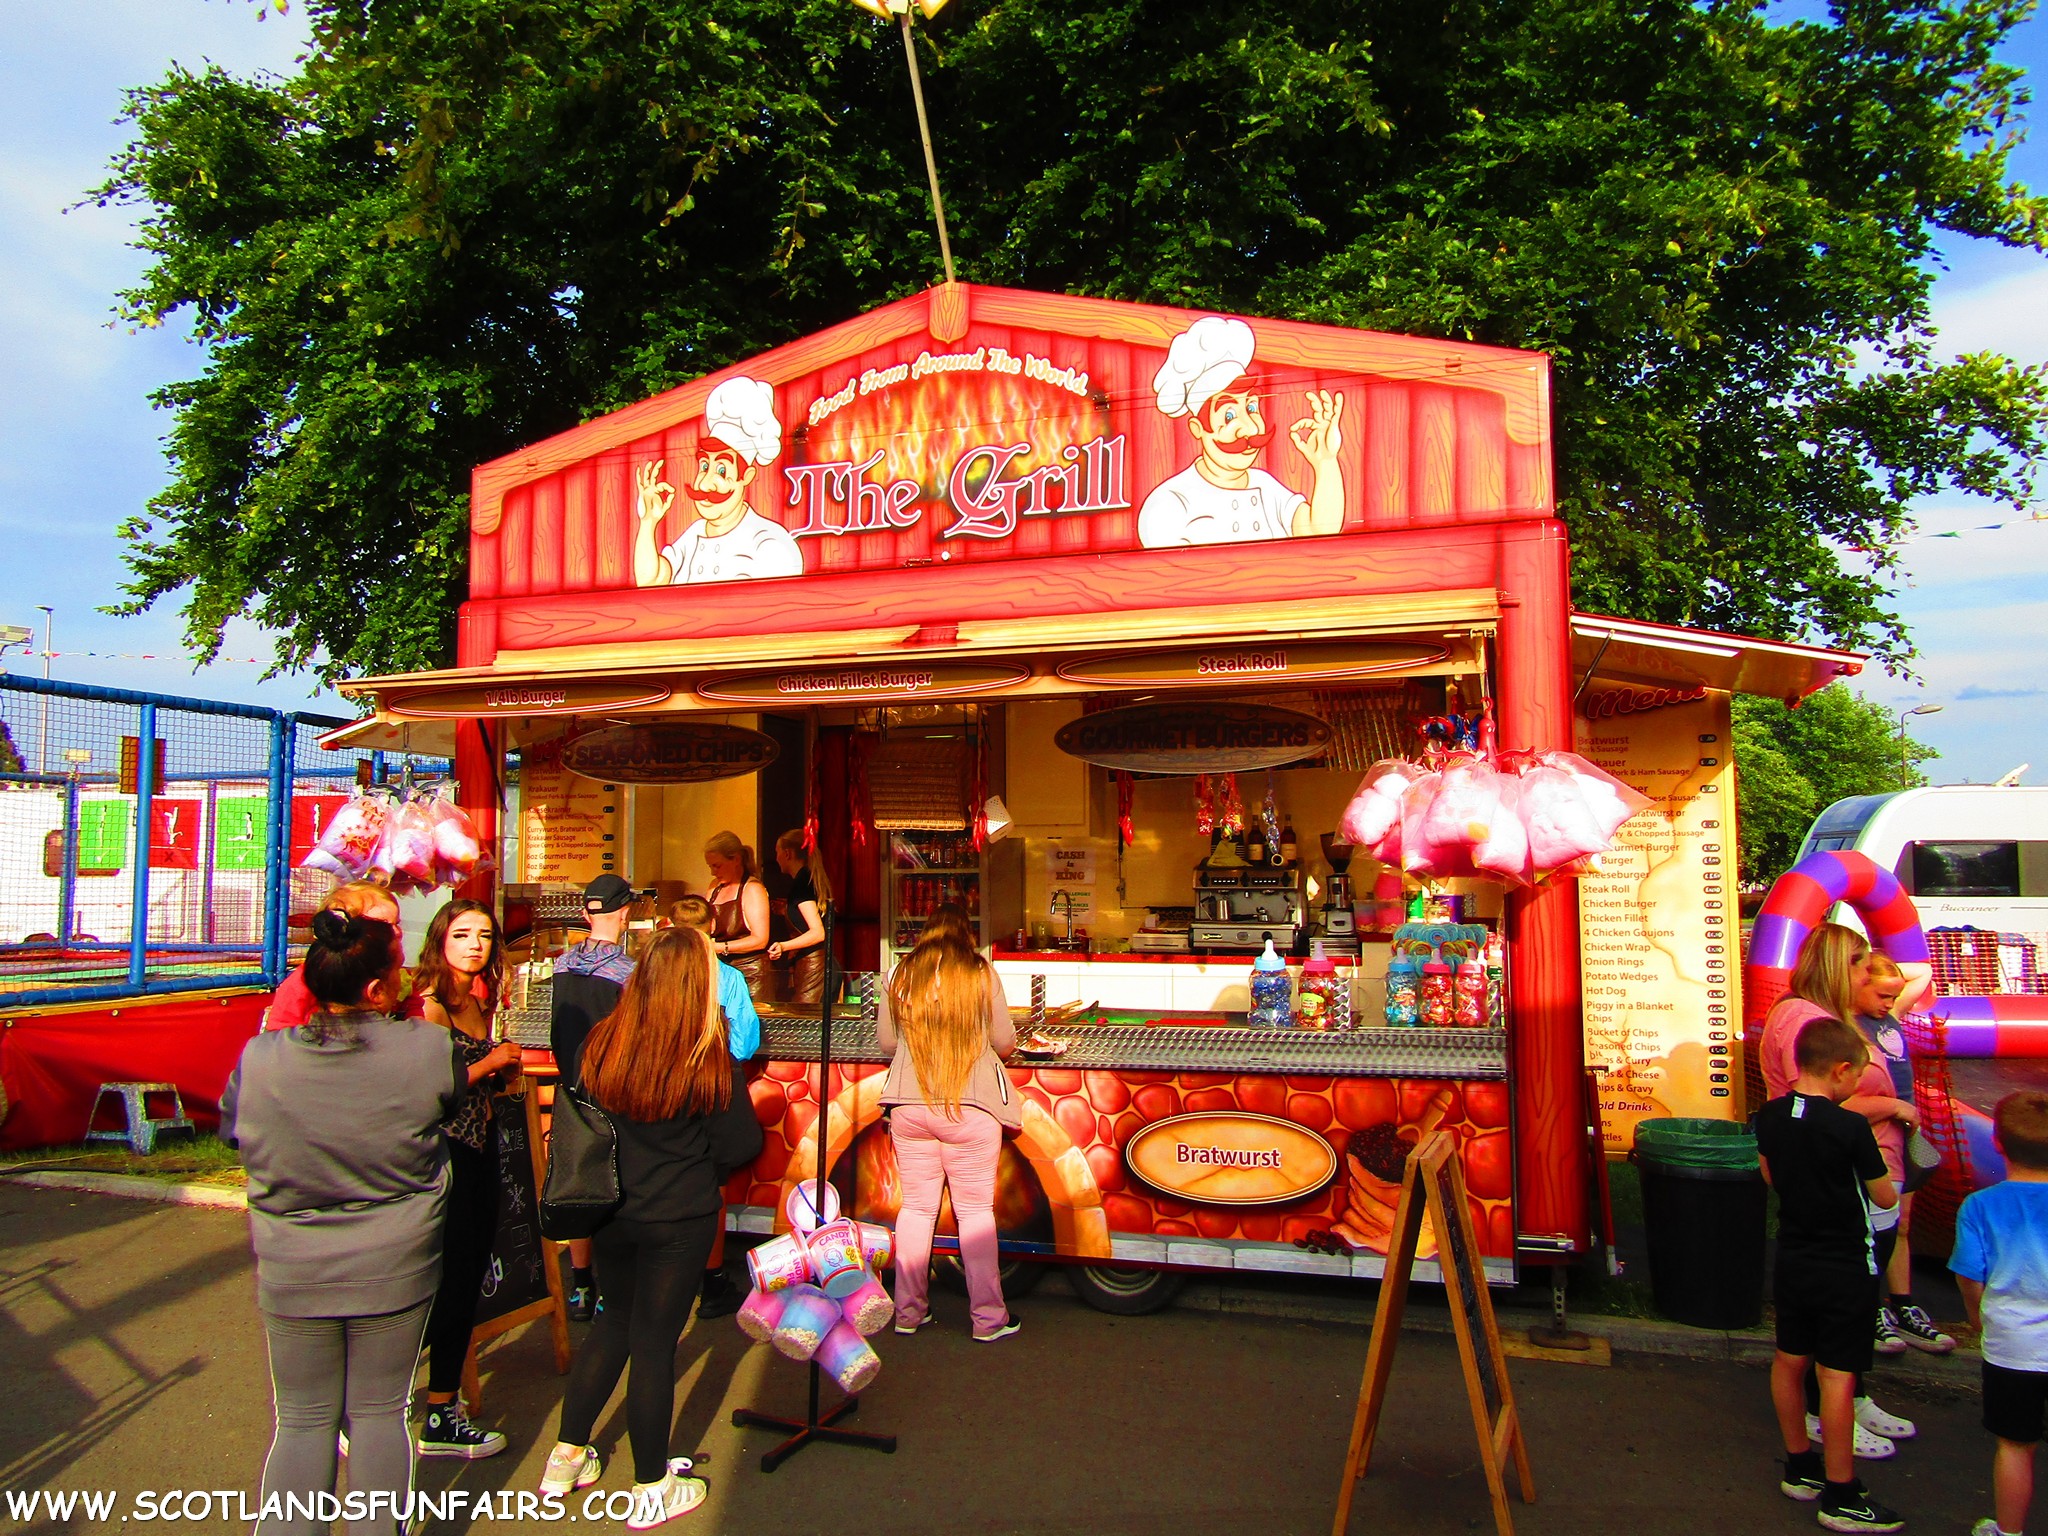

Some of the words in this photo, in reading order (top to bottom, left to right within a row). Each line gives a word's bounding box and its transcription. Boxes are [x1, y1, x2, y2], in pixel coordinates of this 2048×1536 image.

[808, 377, 856, 425] Food
[859, 363, 909, 395] From
[911, 346, 985, 379] Around
[986, 347, 1021, 373] The
[1024, 353, 1089, 397] World
[784, 449, 922, 537] The
[943, 434, 1132, 539] Grill
[1198, 653, 1248, 673] Steak
[1250, 651, 1287, 671] Roll
[777, 674, 837, 693] Chicken
[839, 672, 878, 691] Fillet
[879, 670, 933, 691] Burger
[485, 690, 518, 707] 1/4lb
[519, 688, 566, 707] Burger
[1586, 686, 1708, 719] Menu
[1080, 723, 1194, 749] GOURMET
[1196, 722, 1310, 749] BURGERS
[1578, 736, 1629, 745] Bratwurst
[576, 741, 692, 766] SEASONED
[696, 741, 764, 763] CHIPS
[1592, 759, 1625, 767] kauer
[1657, 769, 1690, 777] Sausage
[1633, 809, 1673, 817] ratwurst
[1622, 820, 1657, 830] Sausage
[1635, 830, 1670, 838] Chopped
[1672, 830, 1705, 838] Sausage
[1610, 844, 1645, 852] urmet
[1647, 844, 1680, 855] Burger
[1056, 851, 1085, 859] CASH
[1601, 856, 1634, 865] Burger
[1056, 872, 1085, 880] KING
[1588, 871, 1649, 880] heeseburger
[1583, 885, 1609, 893] Steak
[1612, 885, 1630, 893] Roll
[1583, 900, 1622, 908] Chicken
[1624, 900, 1657, 909] Burger
[1938, 903, 2001, 913] Buccaneer
[1584, 914, 1623, 922] Chicken
[1624, 914, 1648, 922] Fillet
[1584, 929, 1590, 937] 4
[1592, 928, 1630, 937] Chicken
[1633, 929, 1675, 939] Goujons
[1585, 943, 1623, 951] Chicken
[1624, 944, 1651, 953] Wrap
[1585, 958, 1615, 966] Onion
[1617, 958, 1644, 968] Rings
[1586, 972, 1618, 981] Potato
[1620, 972, 1658, 982] Wedges
[1586, 987, 1603, 995] Hot
[1606, 987, 1626, 997] Dog
[1586, 1002, 1613, 1012] Piggy
[1616, 1002, 1625, 1010] in
[1636, 1002, 1673, 1011] Blanket
[1587, 1014, 1612, 1024] Chips
[1621, 1028, 1631, 1036] of
[1633, 1029, 1659, 1038] Chips
[1635, 1042, 1660, 1052] Chips
[1625, 1057, 1651, 1067] Curry
[1595, 1070, 1614, 1079] hips
[1626, 1071, 1660, 1080] Cheese
[1597, 1084, 1614, 1093] hips
[1617, 1084, 1624, 1092] &
[1626, 1084, 1653, 1094] Gravy
[1598, 1102, 1614, 1111] old
[1618, 1102, 1652, 1111] Drinks
[1602, 1133, 1622, 1142] ttles
[1176, 1143, 1282, 1168] Bratwurst
[819, 1231, 850, 1246] CANDY
